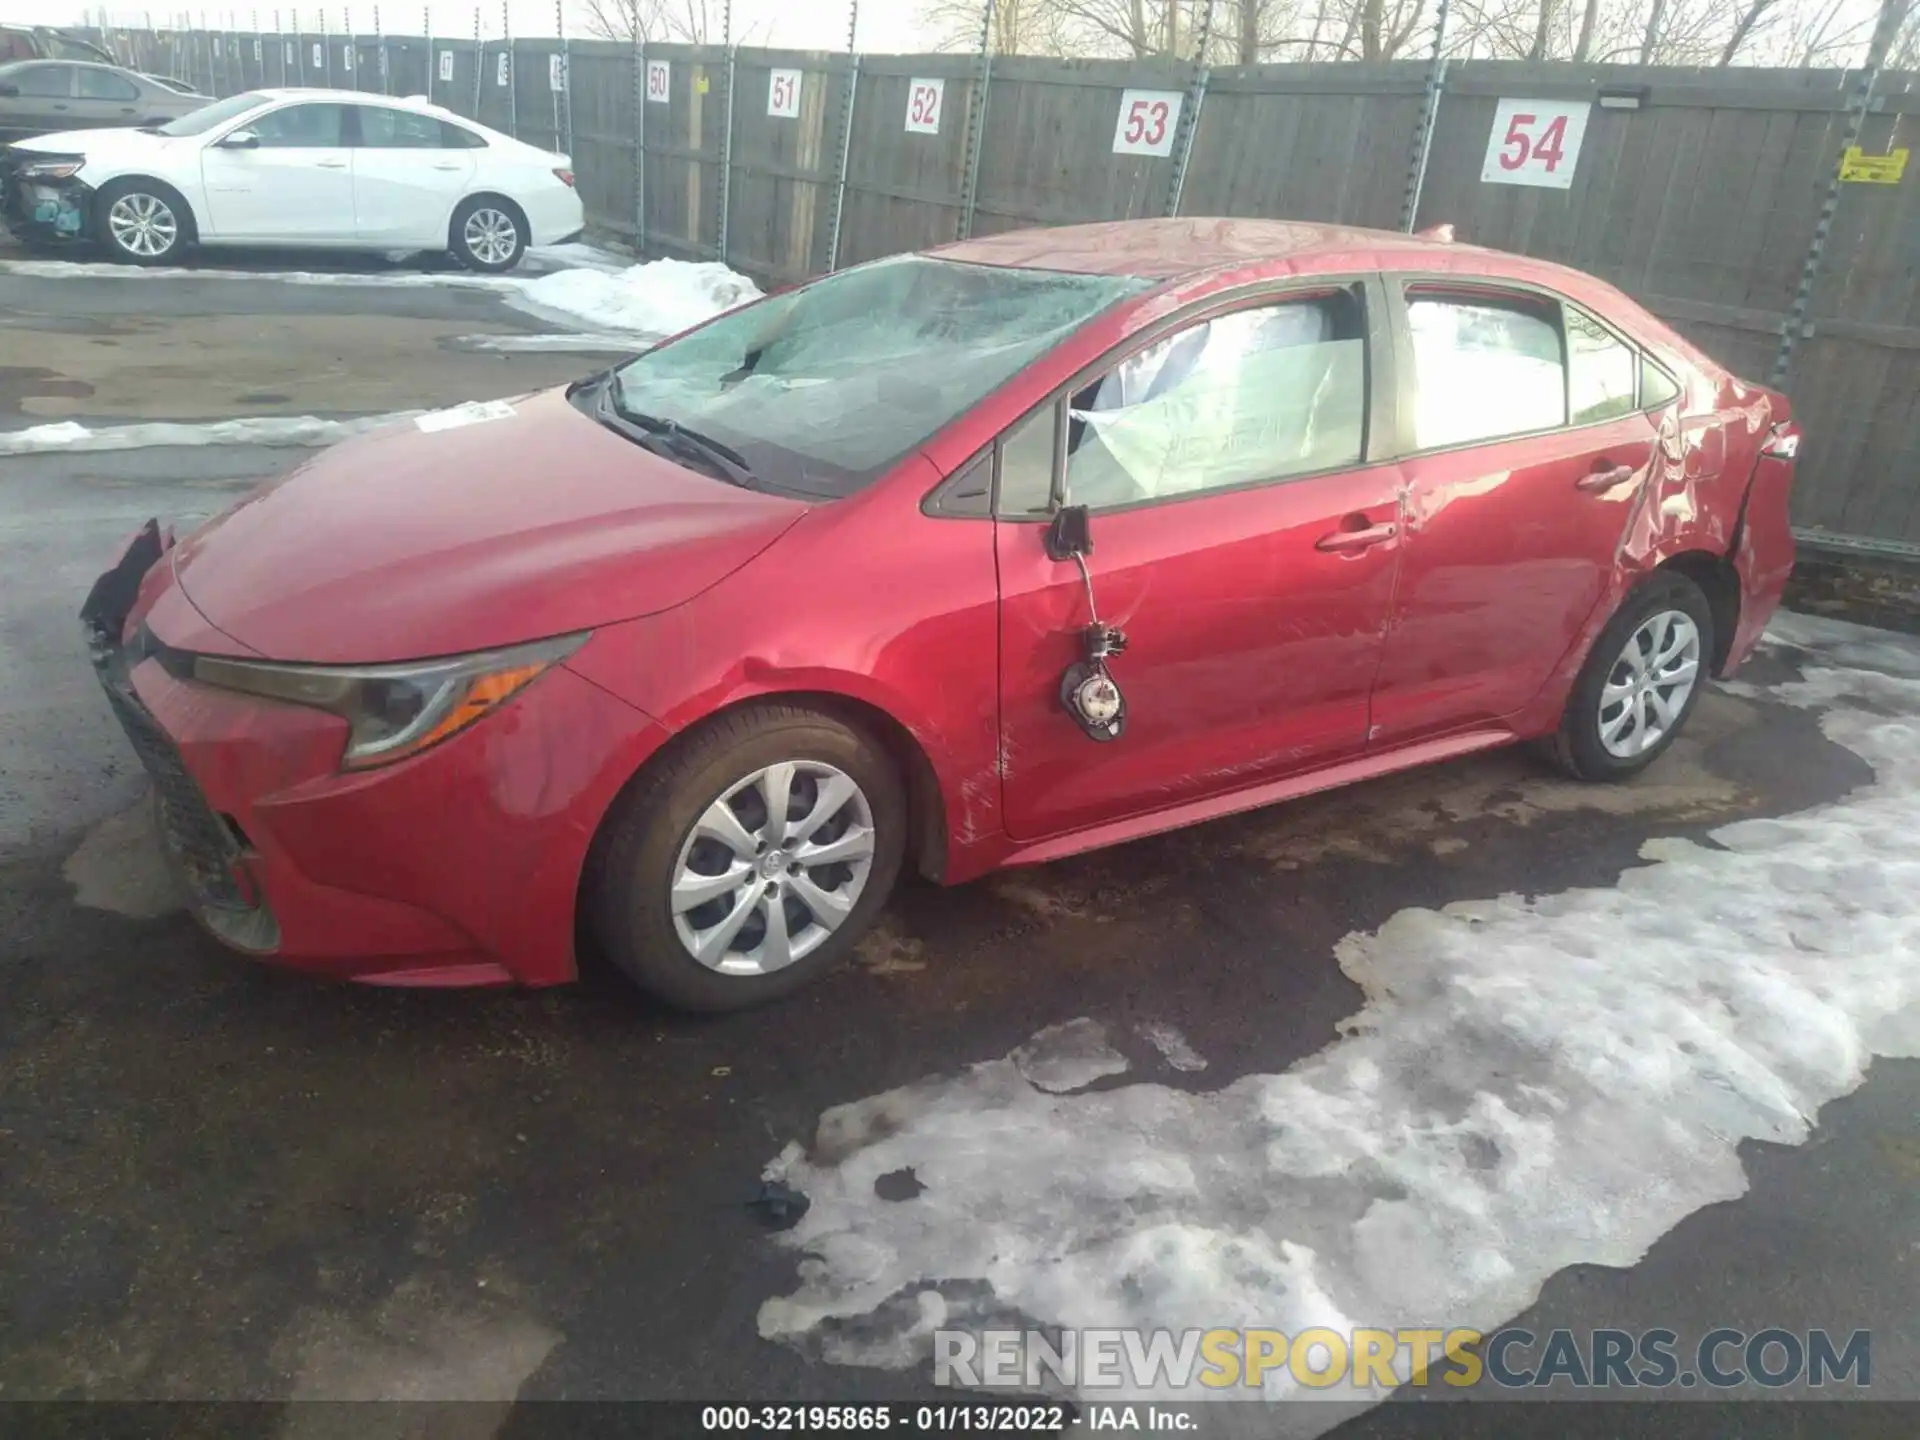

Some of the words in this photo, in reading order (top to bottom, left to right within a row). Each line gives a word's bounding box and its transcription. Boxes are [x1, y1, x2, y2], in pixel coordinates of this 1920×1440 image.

[650, 66, 666, 96] 50
[773, 77, 795, 110] 51
[912, 87, 937, 124] 52
[1124, 101, 1169, 145] 53
[1500, 114, 1568, 172] 54
